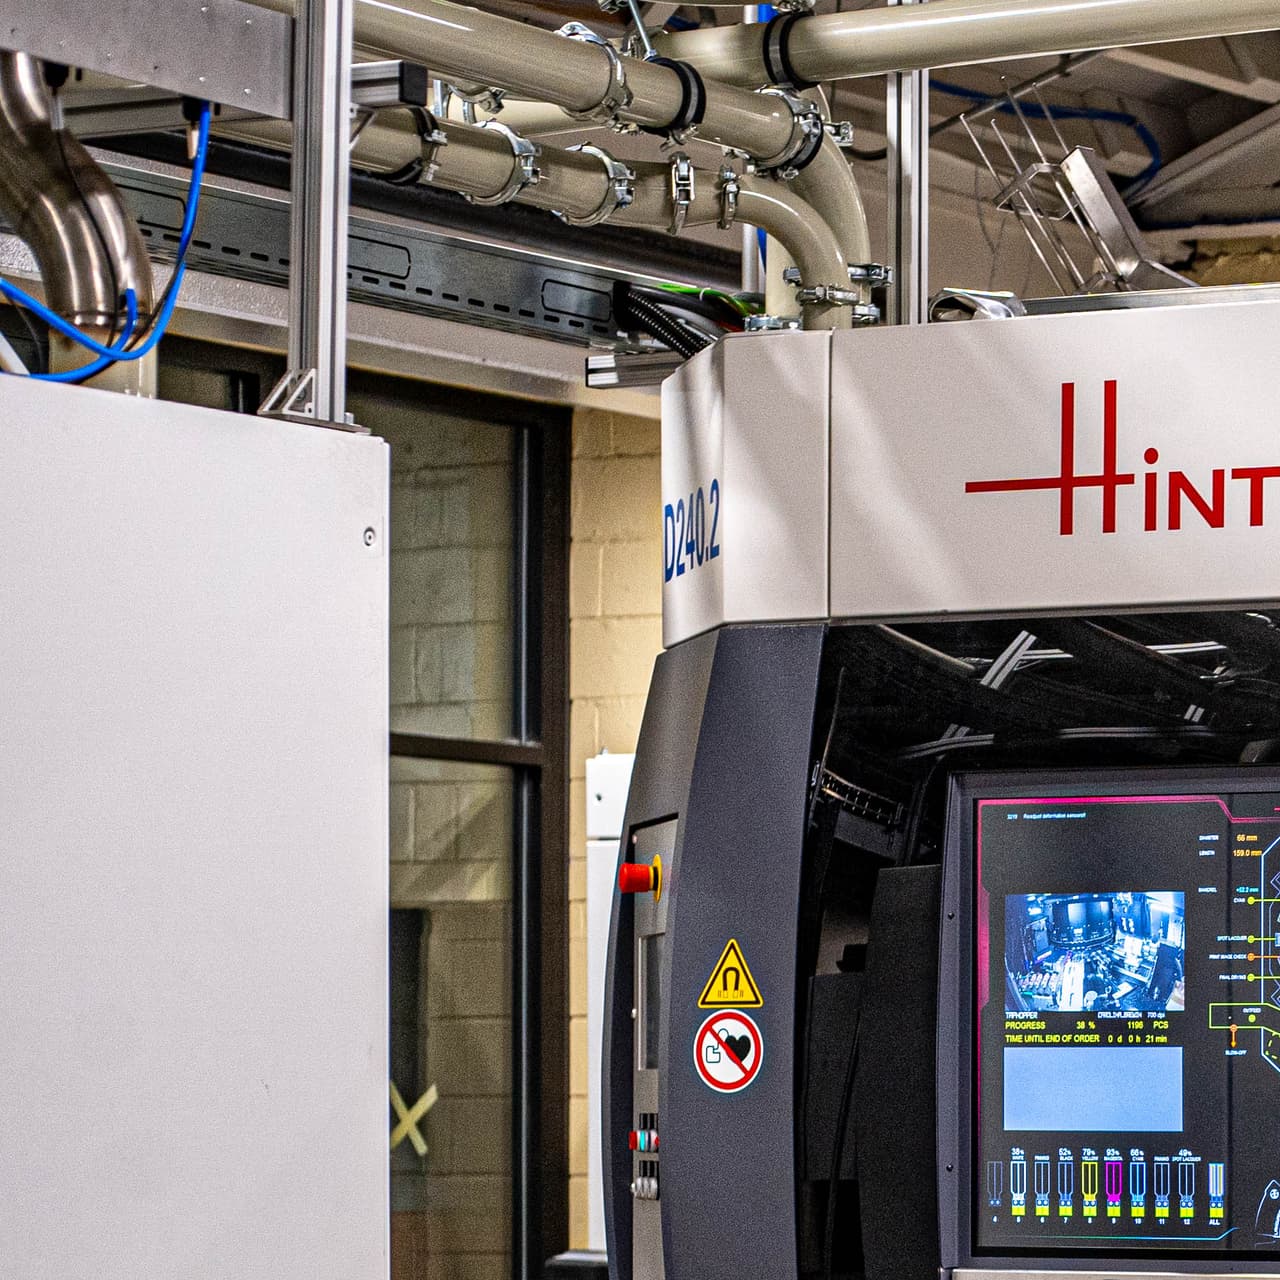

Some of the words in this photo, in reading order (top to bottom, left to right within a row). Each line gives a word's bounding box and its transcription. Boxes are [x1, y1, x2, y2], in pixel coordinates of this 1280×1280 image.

[664, 479, 720, 583] D240.2
[1005, 1021, 1046, 1030] PROGRESS
[1076, 1021, 1086, 1029] 38
[1087, 1021, 1096, 1029] %
[1127, 1021, 1144, 1029] 1196
[1153, 1021, 1169, 1029] PCS
[1005, 1034, 1023, 1043] TIME
[1024, 1034, 1045, 1043] UNTIL
[1045, 1034, 1060, 1043] END
[1061, 1034, 1073, 1043] OF
[1073, 1034, 1100, 1043] ORDER
[1145, 1034, 1155, 1043] 21
[1155, 1034, 1168, 1043] min
